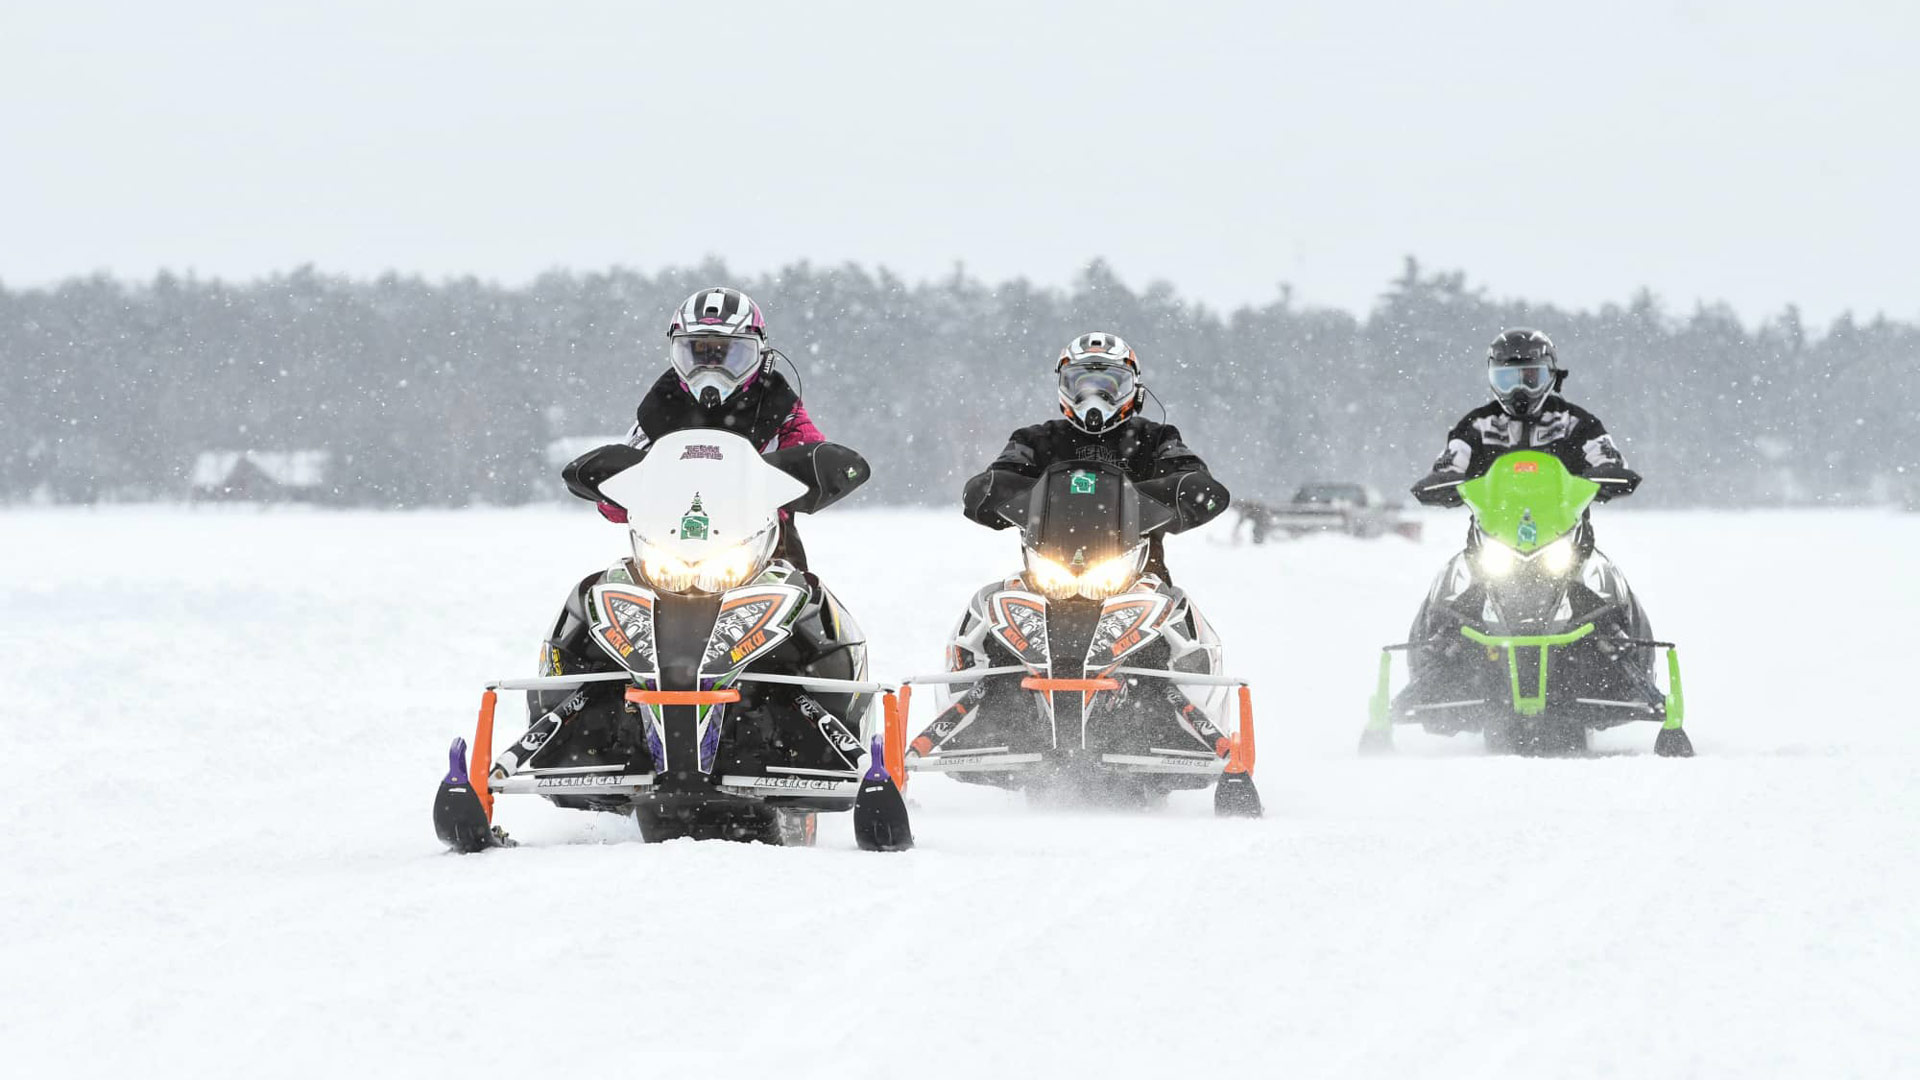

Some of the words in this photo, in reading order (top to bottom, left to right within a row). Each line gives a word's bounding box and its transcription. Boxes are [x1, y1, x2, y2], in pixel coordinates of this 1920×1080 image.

[604, 628, 624, 650] ARCTIC
[619, 642, 634, 658] CAT
[730, 637, 757, 663] ARCTIC
[752, 630, 767, 647] CAT
[563, 691, 588, 715] FOX
[795, 695, 819, 719] FOX
[520, 732, 547, 750] OX
[538, 777, 592, 787] ARCTIC
[597, 775, 623, 785] CAT
[754, 776, 808, 788] ARCTIC
[810, 780, 838, 790] CAT
